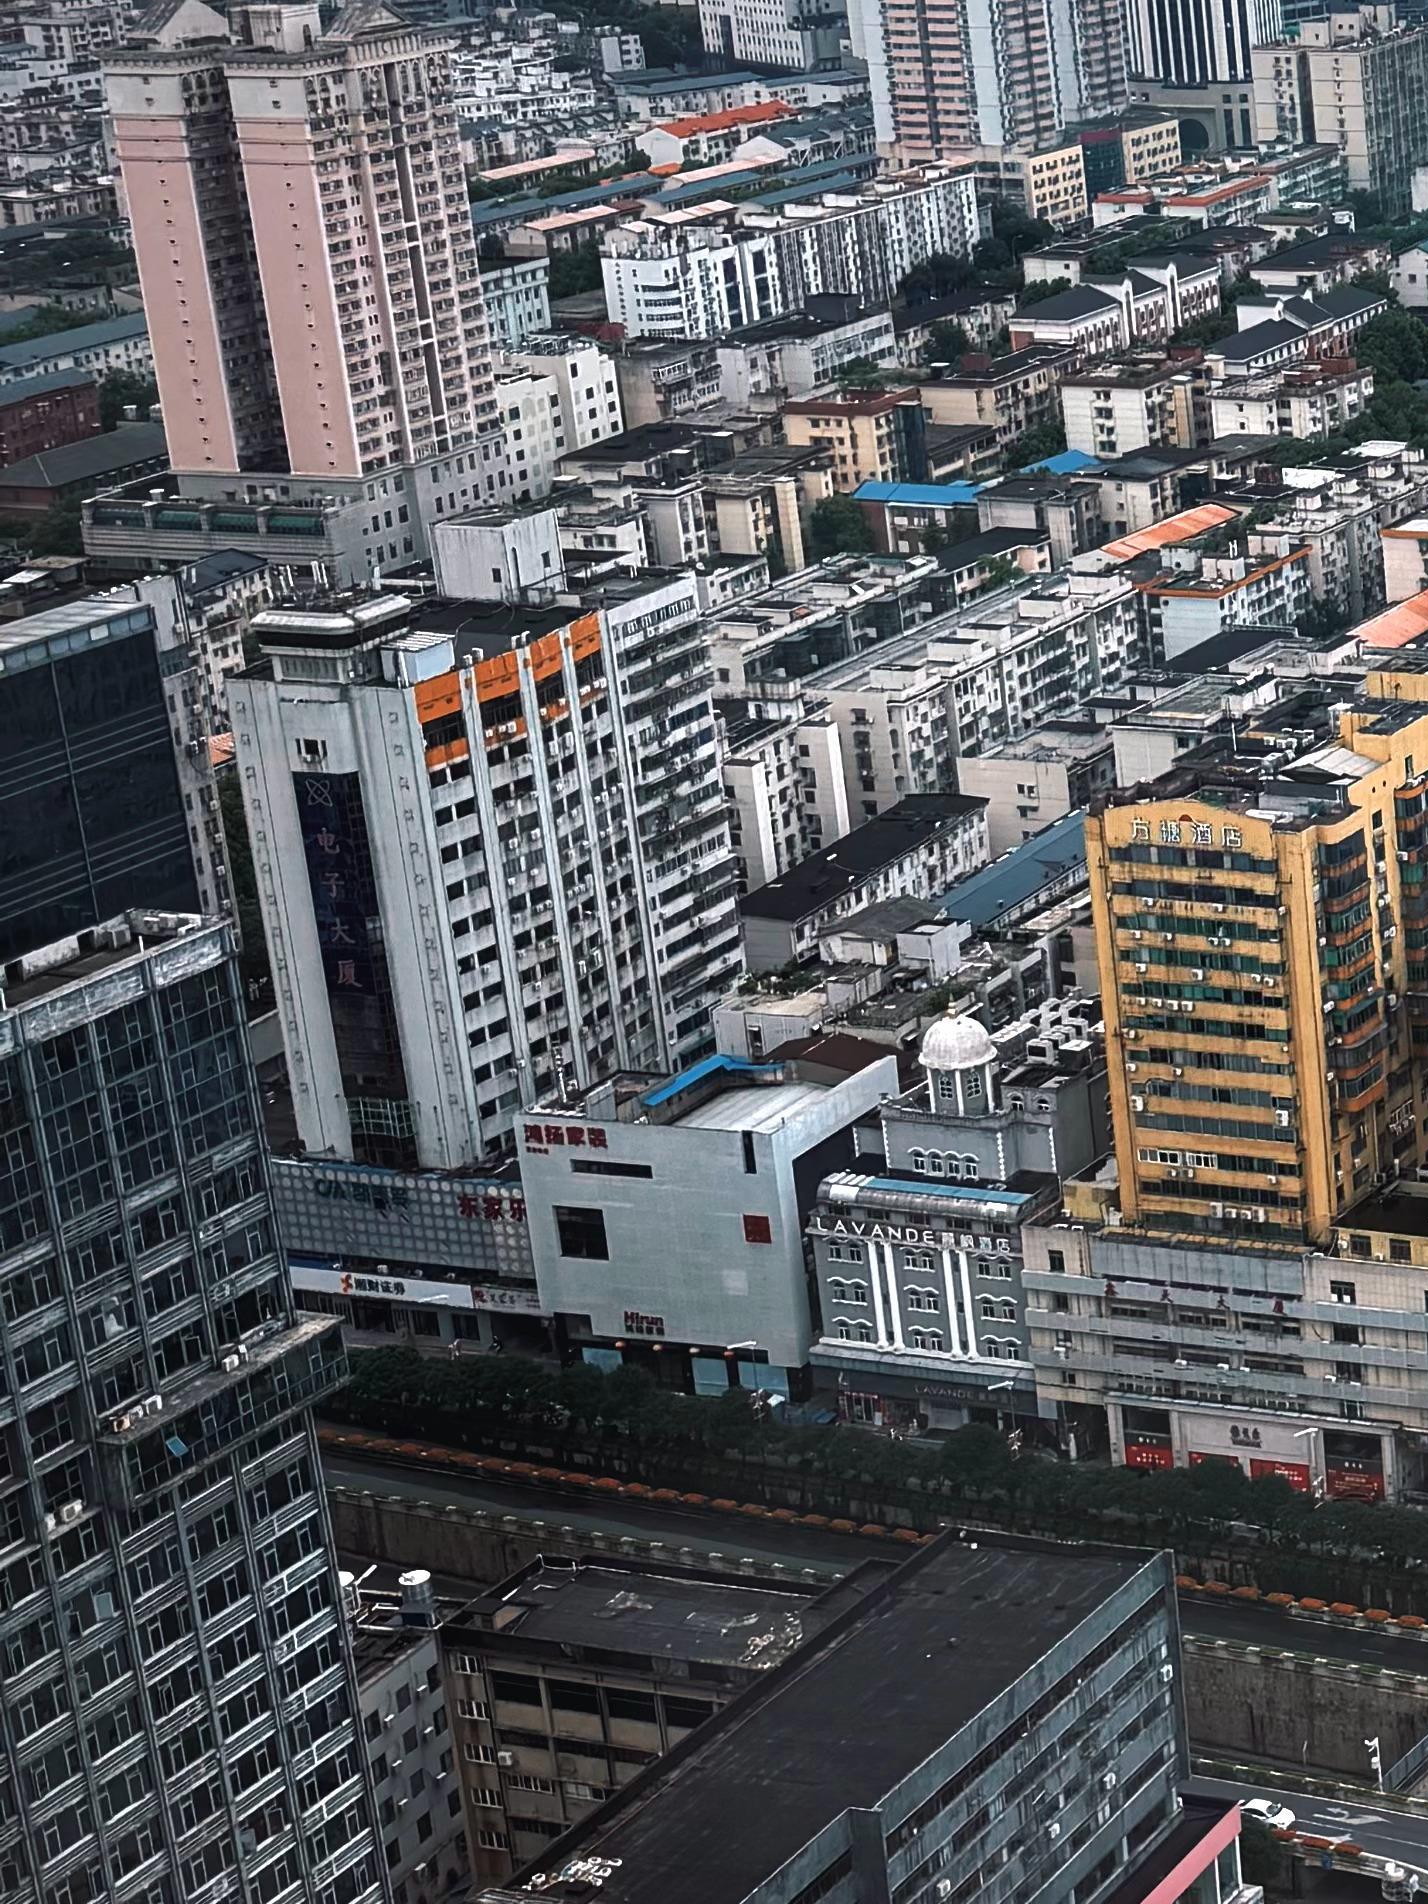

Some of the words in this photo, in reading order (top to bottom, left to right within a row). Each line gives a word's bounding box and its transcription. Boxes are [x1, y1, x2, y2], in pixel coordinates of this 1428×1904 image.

[317, 827, 363, 987] 电子大厦
[816, 1217, 935, 1244] LAVANDE
